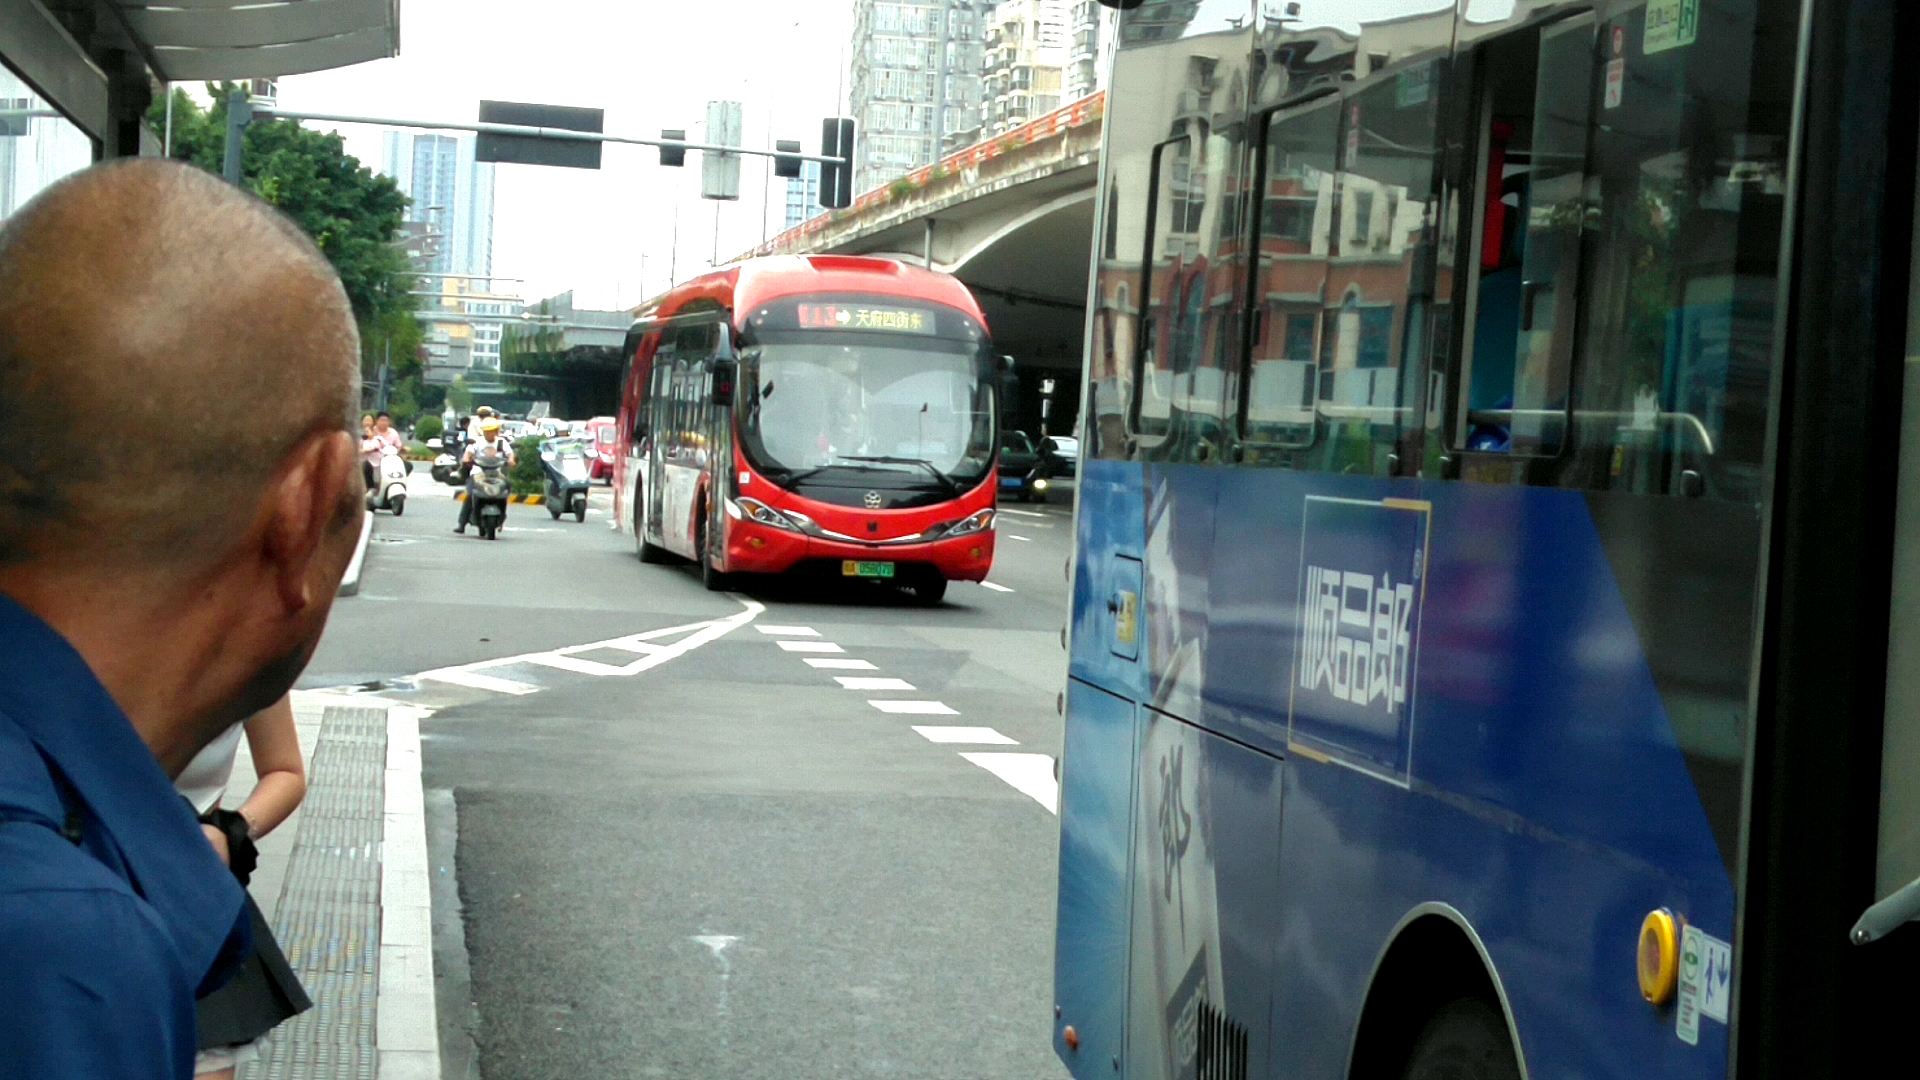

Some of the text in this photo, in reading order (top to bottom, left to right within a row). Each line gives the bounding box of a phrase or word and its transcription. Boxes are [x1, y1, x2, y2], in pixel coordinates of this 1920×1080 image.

[855, 309, 922, 329] 天府四街东
[1300, 565, 1414, 714] 顺品郎
